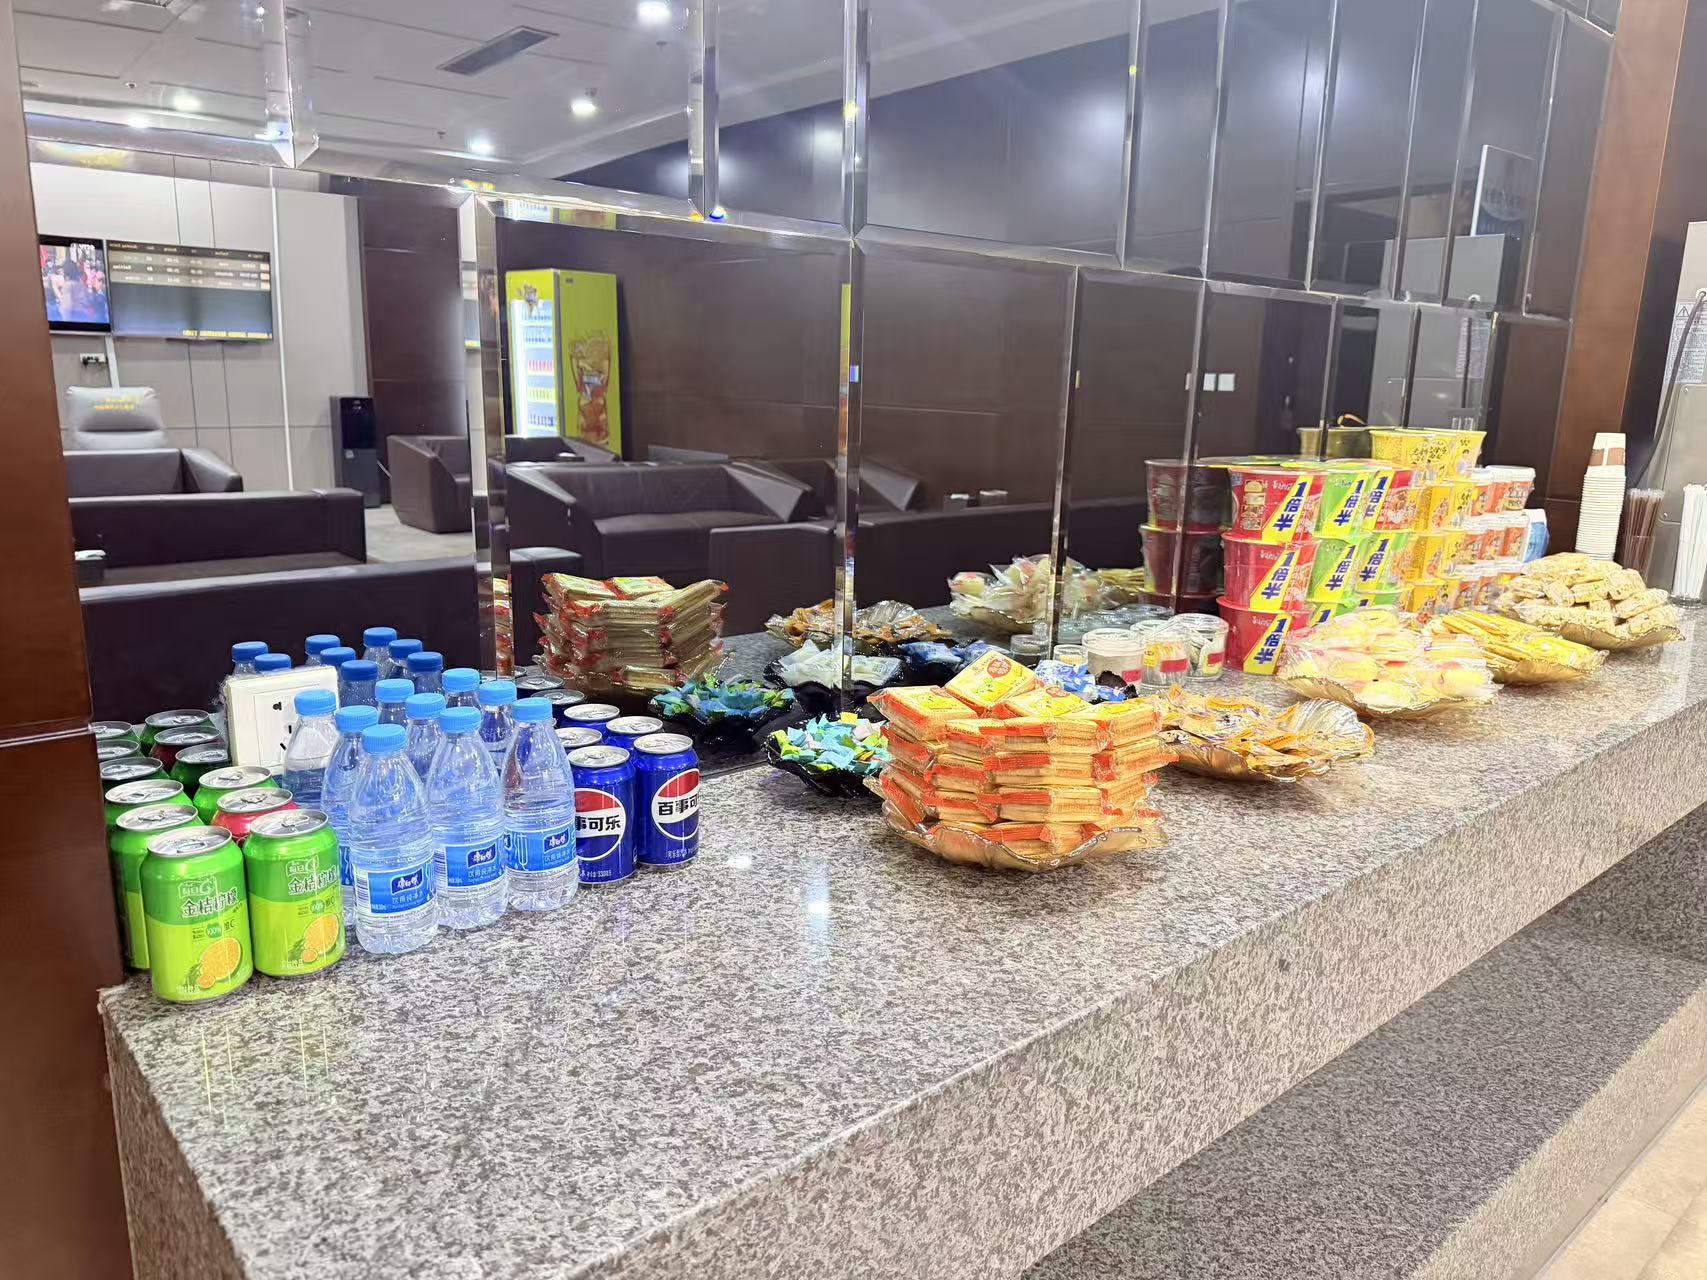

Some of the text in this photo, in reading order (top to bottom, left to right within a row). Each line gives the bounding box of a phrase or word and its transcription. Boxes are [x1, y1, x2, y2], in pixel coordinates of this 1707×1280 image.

[1272, 481, 1308, 532] 1倍半
[1254, 618, 1287, 664] 1倍半
[658, 794, 699, 816] 百事可
[575, 814, 621, 832] 事可乐
